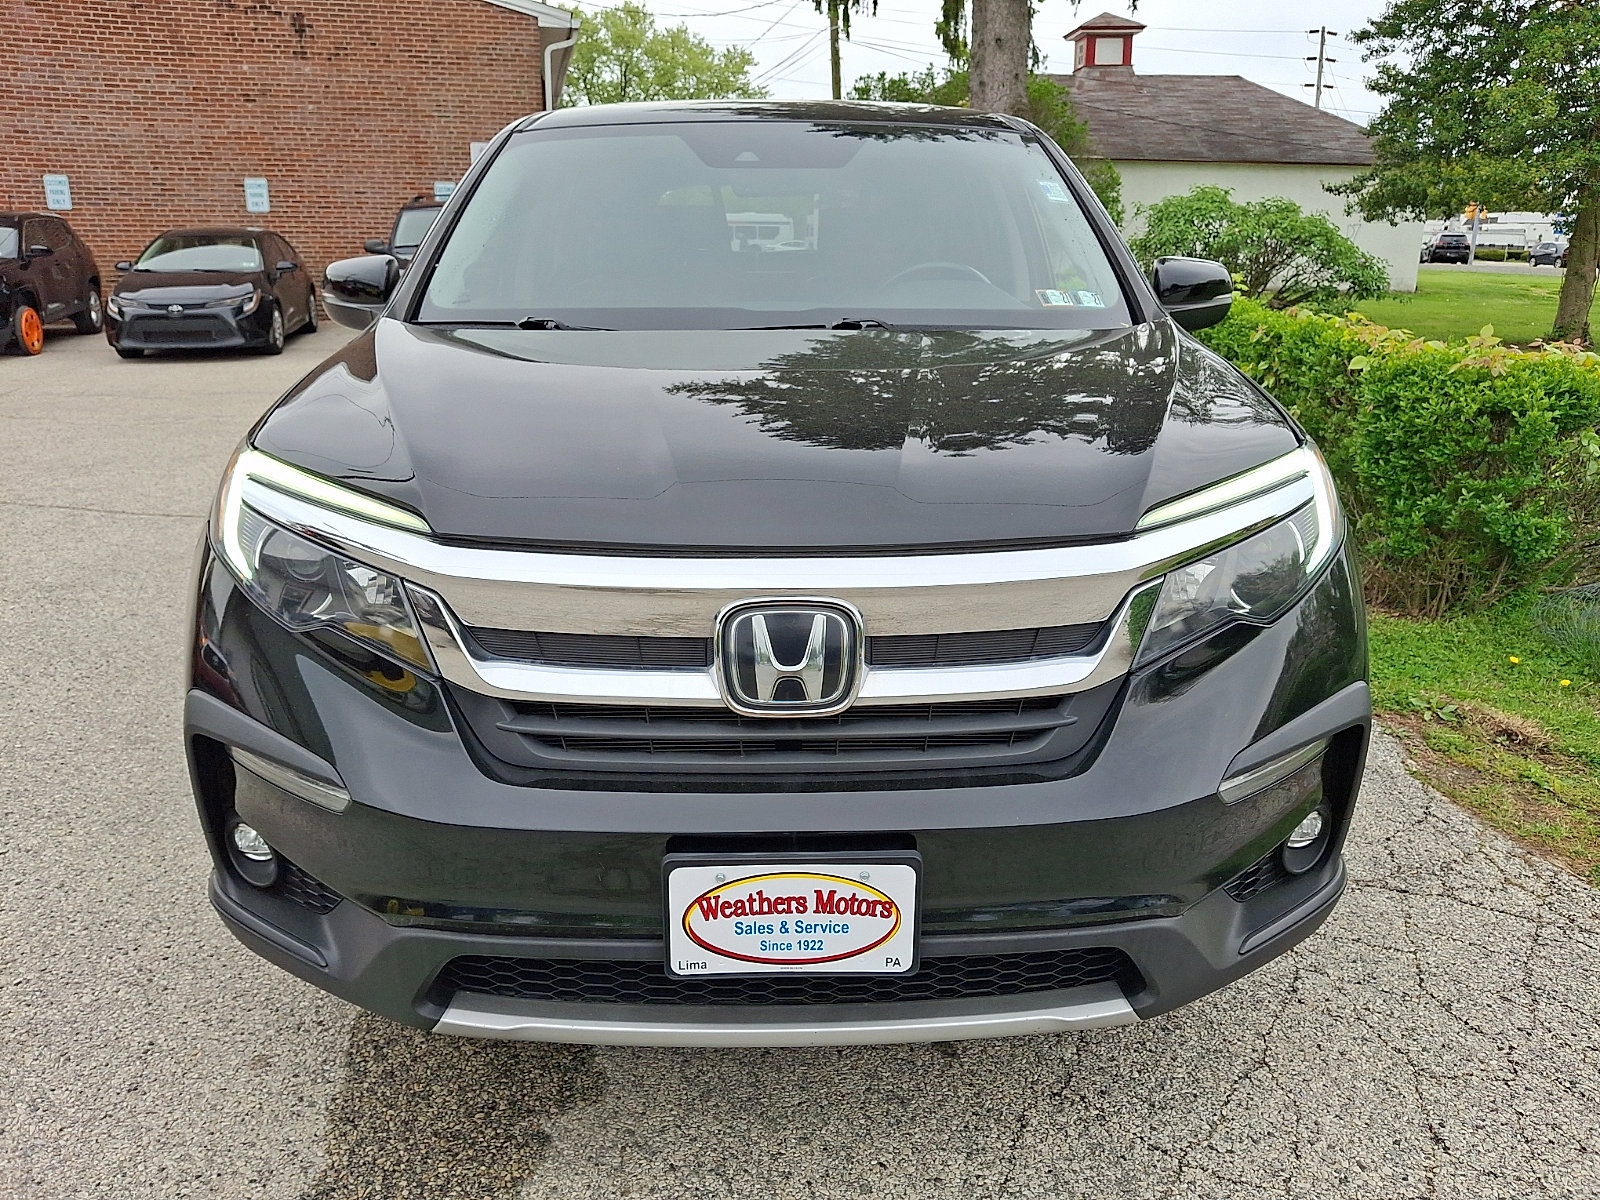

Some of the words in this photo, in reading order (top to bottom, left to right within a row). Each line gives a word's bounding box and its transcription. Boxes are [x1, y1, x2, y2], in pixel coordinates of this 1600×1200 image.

[696, 890, 808, 921] Weathers
[813, 889, 894, 919] Motors
[734, 920, 775, 935] Sales
[779, 920, 790, 934] &
[794, 920, 850, 934] Service
[759, 940, 793, 951] Since
[796, 940, 824, 951] 1922
[678, 961, 708, 971] Lima
[885, 957, 902, 968] PA
